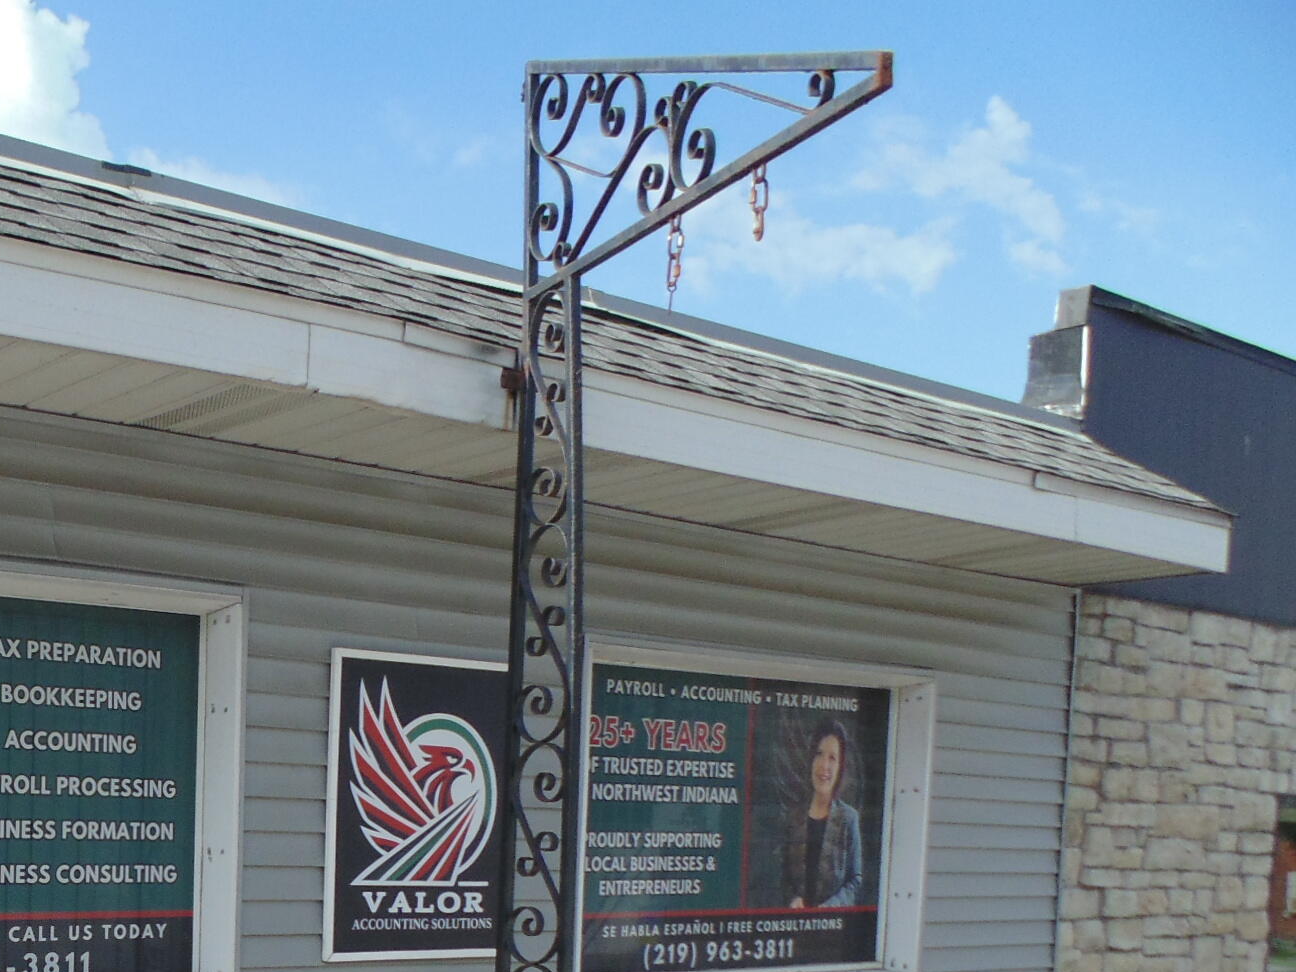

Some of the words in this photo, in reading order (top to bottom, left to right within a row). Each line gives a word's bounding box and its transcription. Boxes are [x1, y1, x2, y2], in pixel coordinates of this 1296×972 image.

[27, 640, 161, 669] PREPARATION
[0, 684, 142, 711] BOOKKEEPING
[606, 679, 665, 698] PAYROLL
[680, 685, 762, 704] ACCOUNTING
[775, 692, 799, 708] TAX
[801, 695, 859, 712] PLANNING
[4, 729, 137, 754] ACCOUNTING
[589, 714, 635, 749] 25+
[642, 717, 727, 754] YEARS
[603, 756, 663, 776] TRUSTED
[666, 760, 736, 778] EXPERTISE
[56, 776, 177, 799] PROCESSING
[591, 783, 681, 803] NORTHWEST
[682, 786, 739, 804] INDIANA
[62, 820, 174, 841] FORMATION
[644, 832, 722, 849] SUPPORTING
[56, 864, 178, 884] CONSULTING
[585, 855, 627, 872] LOCAL
[630, 856, 704, 872] BUSINESSES
[705, 857, 716, 871] &
[598, 879, 701, 896] ENTREPRENEURS
[362, 891, 484, 914] VALOR
[8, 925, 58, 943] CALL
[68, 924, 93, 941] US
[102, 923, 168, 940] TODAY
[352, 917, 429, 930] ACCOUNTING
[431, 917, 493, 930] SOLUTIONS
[602, 925, 616, 938] SE
[621, 923, 660, 937] HABLA
[664, 919, 716, 935] ESPAÑOL
[727, 921, 752, 934] FREE
[756, 918, 843, 933] CONSULTATIONS
[643, 941, 697, 971] (219)
[706, 938, 794, 962] 963-3811
